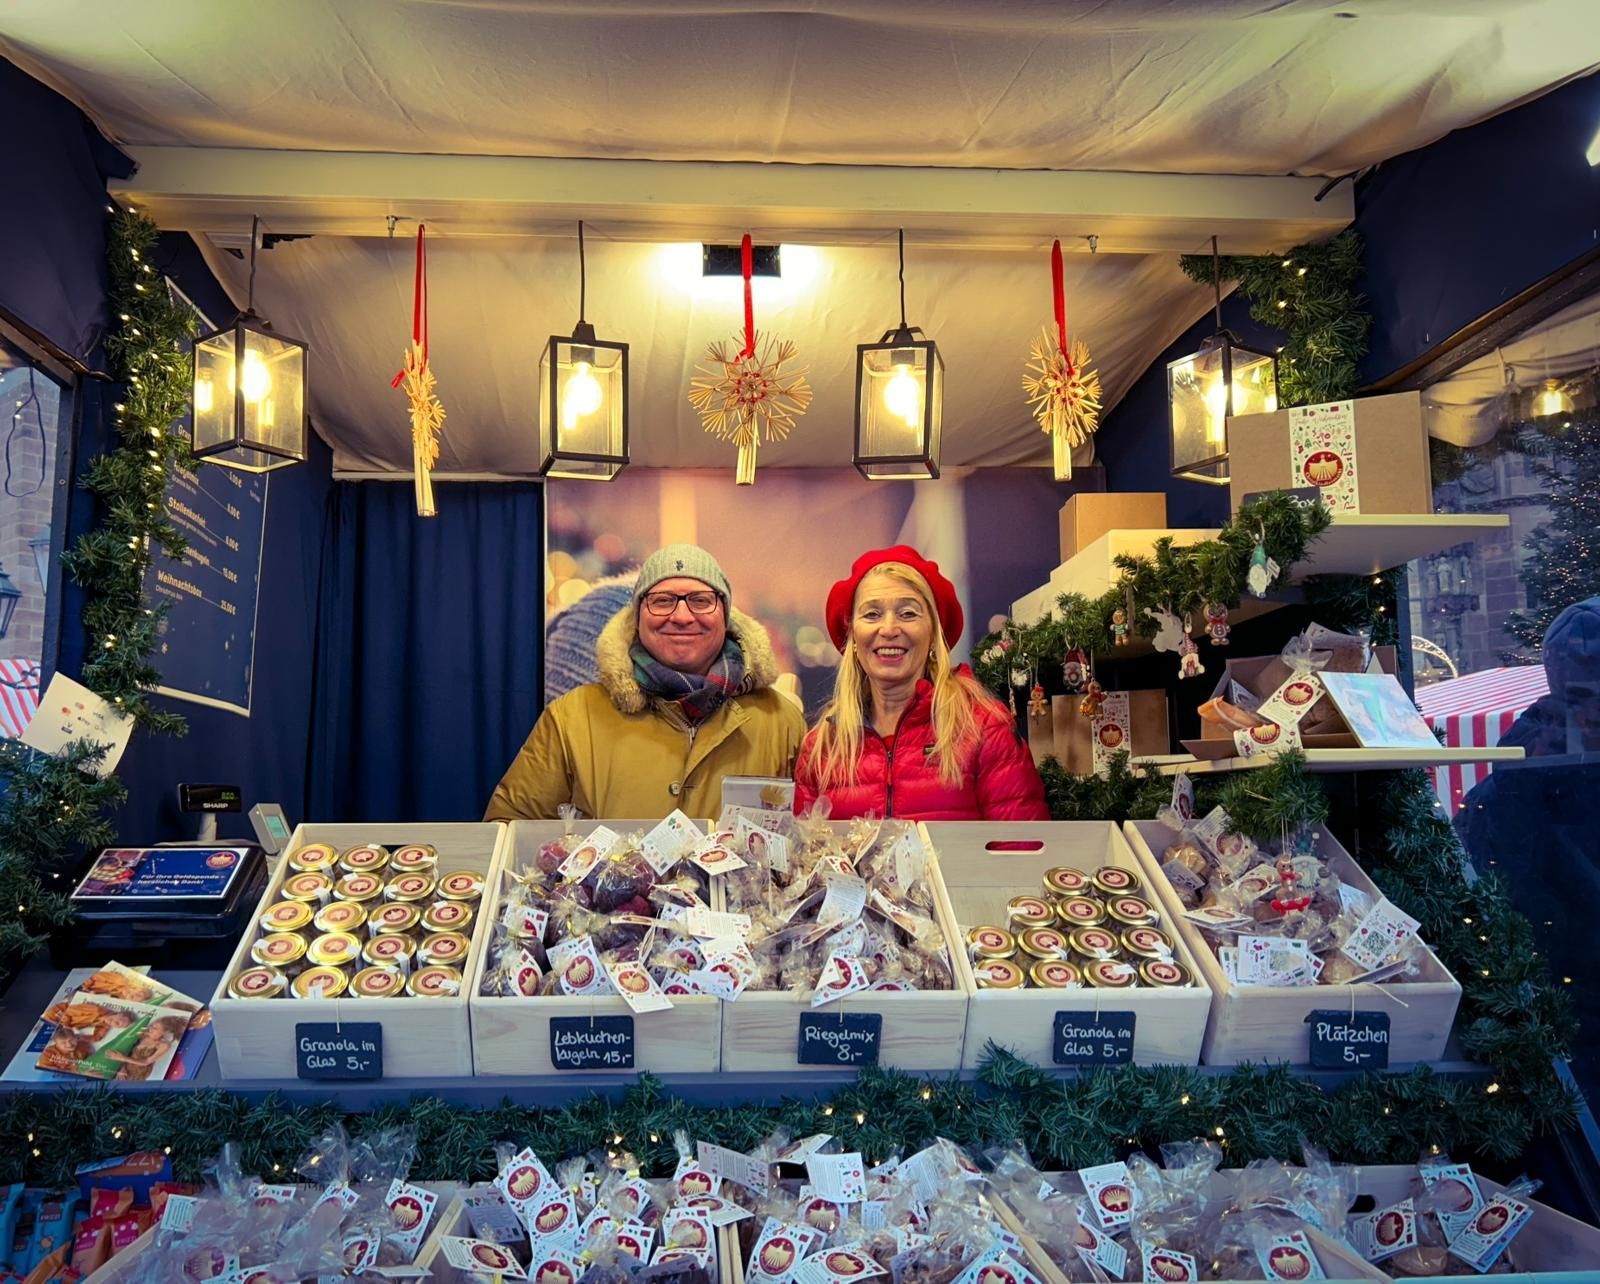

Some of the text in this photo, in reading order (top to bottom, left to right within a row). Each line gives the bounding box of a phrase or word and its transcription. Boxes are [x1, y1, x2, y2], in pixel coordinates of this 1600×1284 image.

[158, 569, 202, 598] Weihnachtsbox
[554, 1030, 632, 1047] Lebkuchen-
[804, 1025, 875, 1049] Riegelmix
[1062, 1023, 1132, 1040] Granola im
[1316, 1022, 1388, 1044] Plätzchen
[300, 1037, 376, 1052] Granola im
[837, 1043, 863, 1062] 8,-
[1063, 1041, 1129, 1058] Glas 5,-
[306, 1055, 371, 1071] Glas 5,-
[602, 1051, 633, 1065] 15,-
[1342, 1046, 1372, 1064] 5,-
